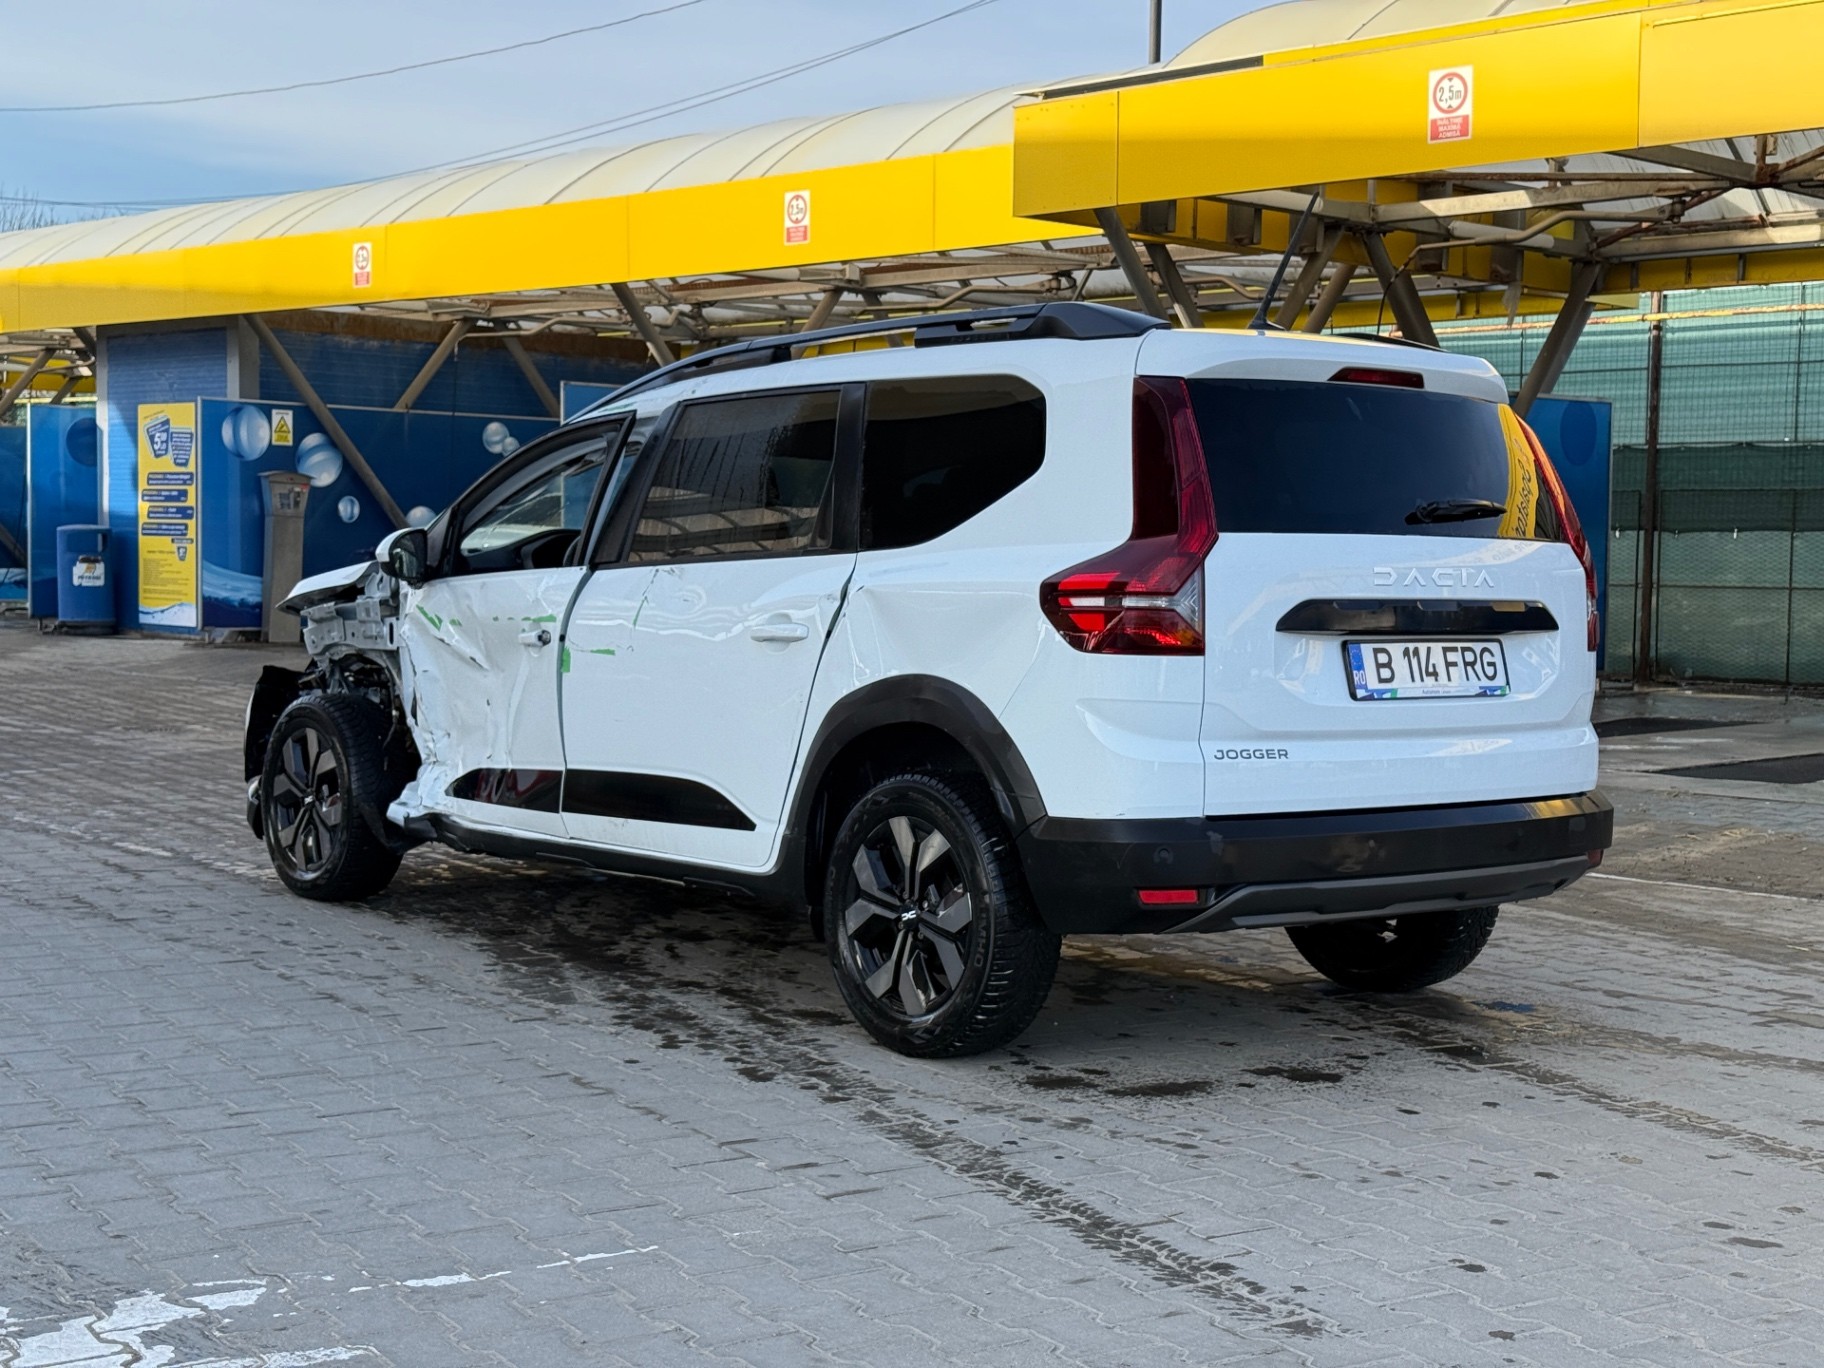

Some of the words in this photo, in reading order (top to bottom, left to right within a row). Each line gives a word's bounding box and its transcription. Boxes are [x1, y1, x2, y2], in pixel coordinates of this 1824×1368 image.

[1438, 85, 1462, 104] 2,5m
[1372, 567, 1495, 588] DACIA
[1372, 647, 1396, 684] B
[1402, 646, 1439, 683] 114
[1441, 646, 1498, 683] FRG
[1353, 670, 1366, 686] RO
[1213, 748, 1289, 760] JOGGER
